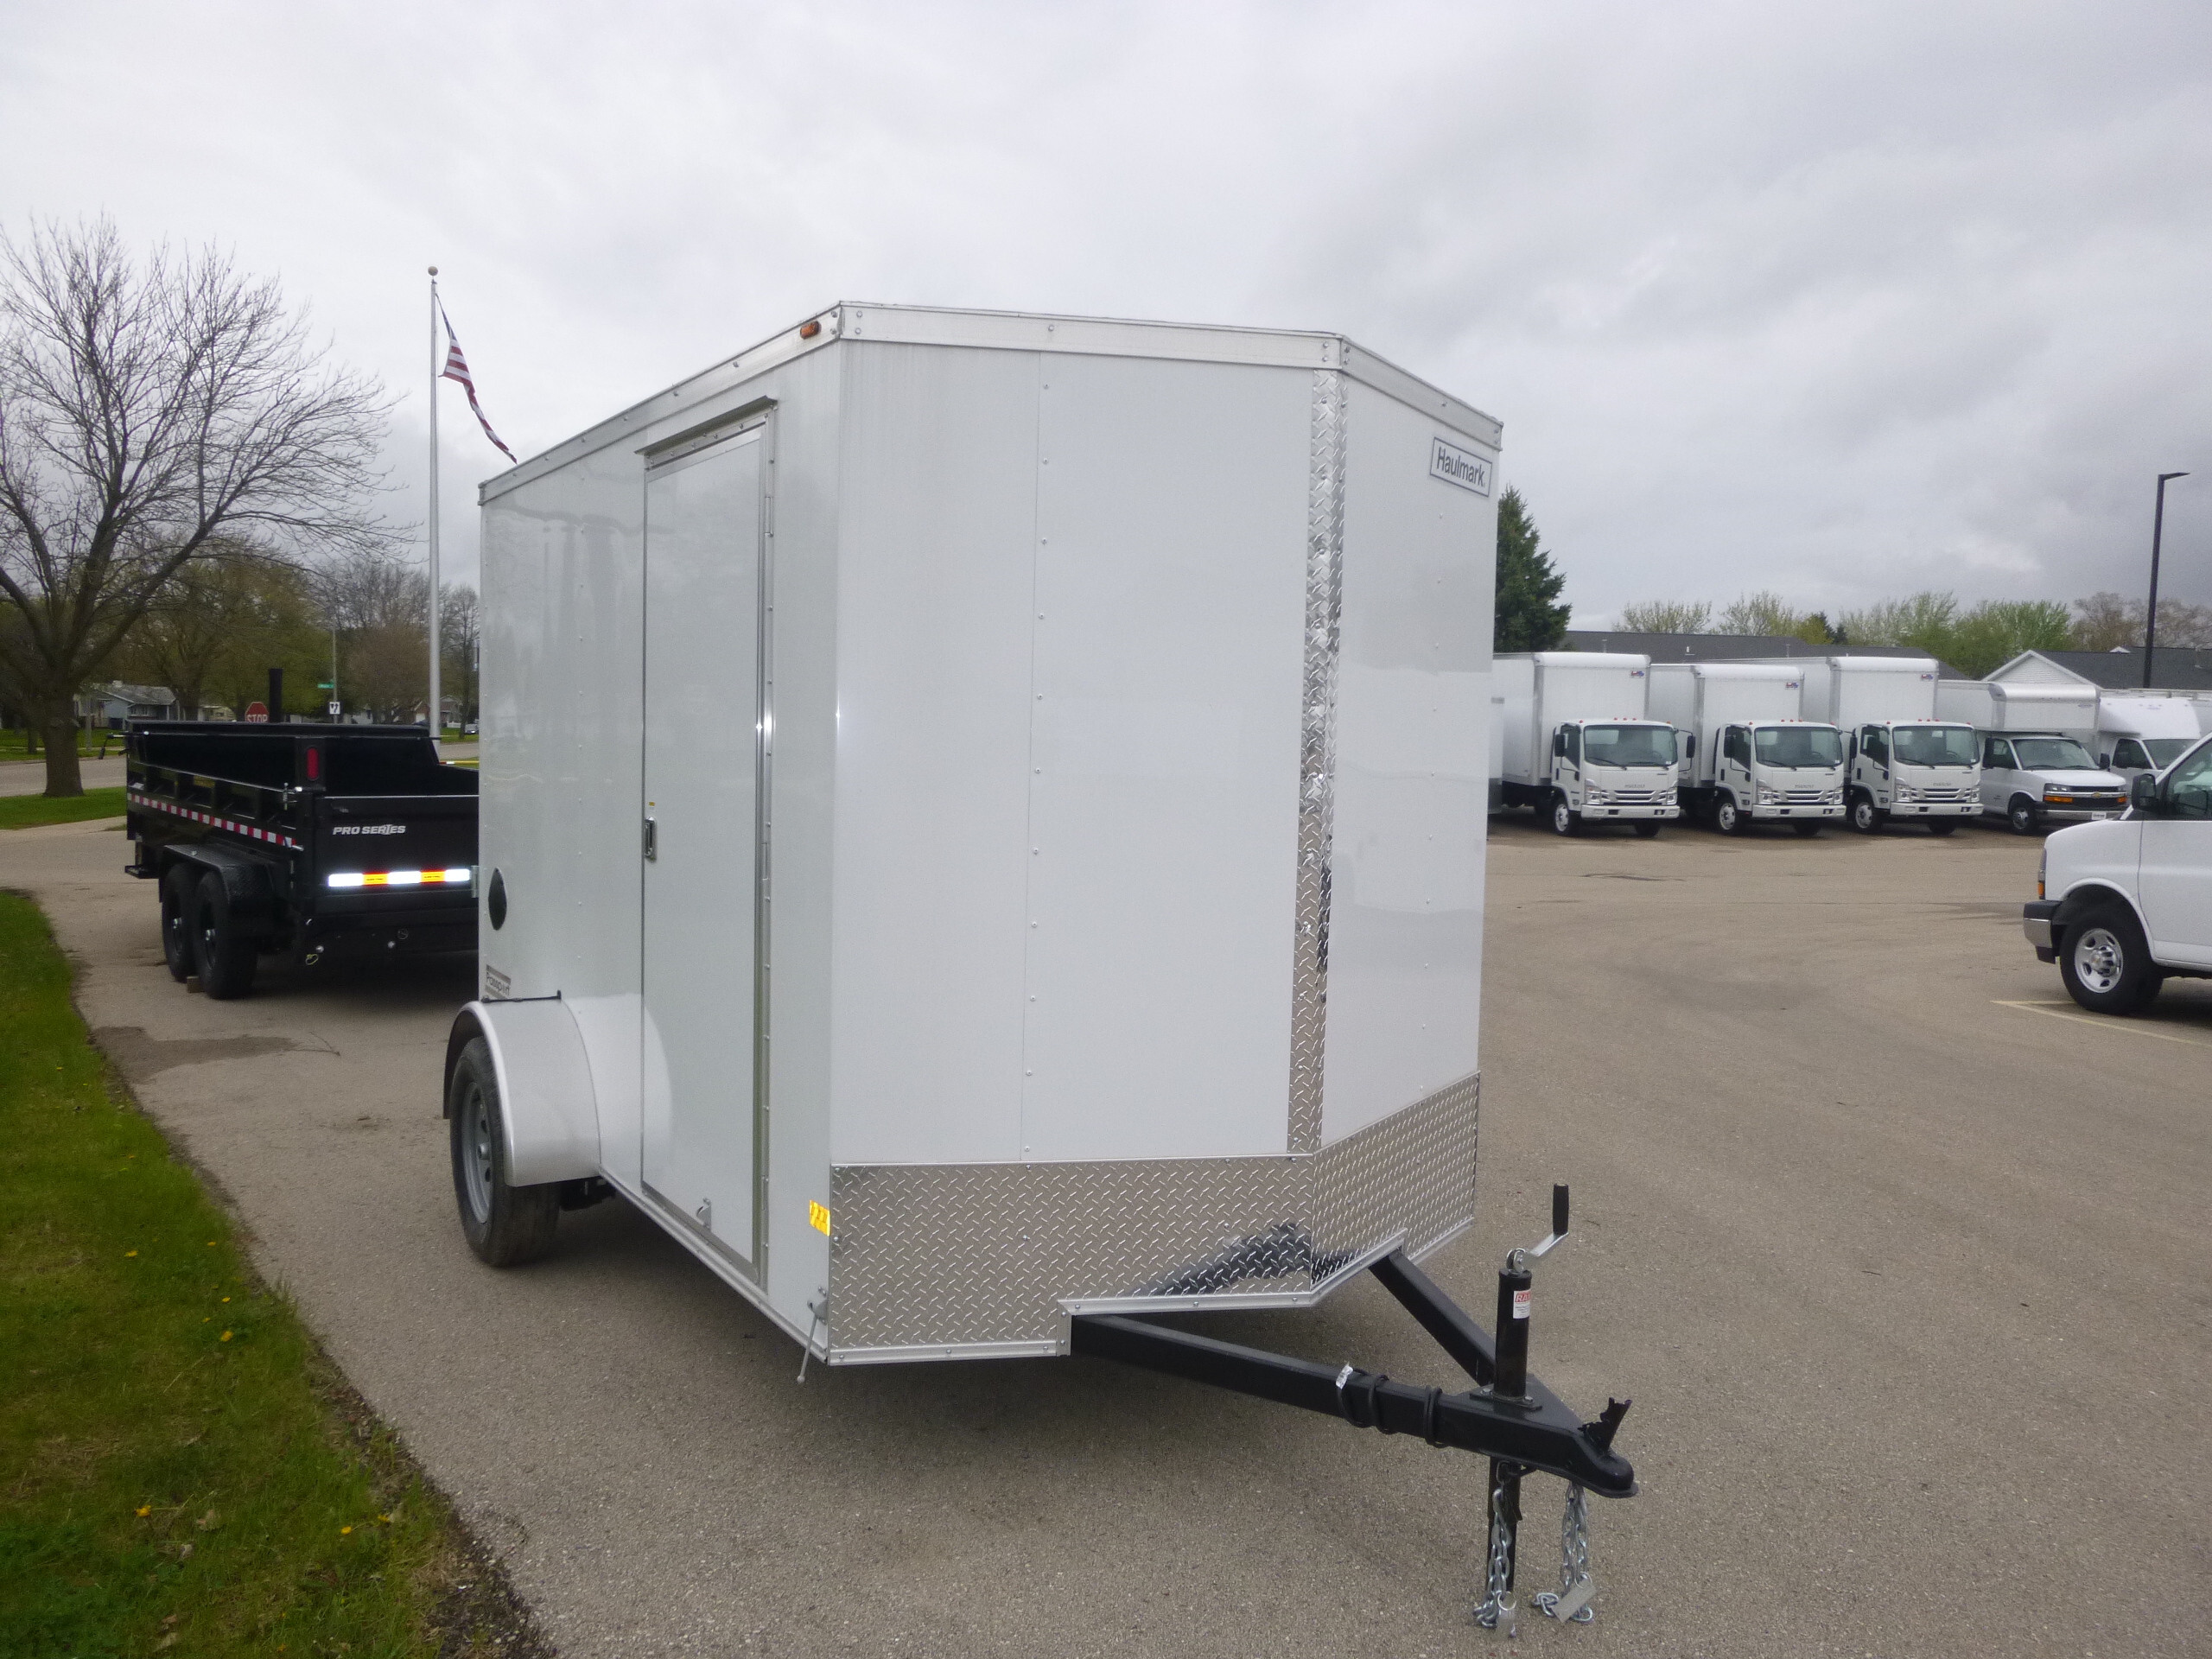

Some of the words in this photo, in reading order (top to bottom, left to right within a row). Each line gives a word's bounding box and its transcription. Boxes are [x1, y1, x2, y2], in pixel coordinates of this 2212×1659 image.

[1436, 446, 1485, 487] Haulmark
[247, 714, 268, 723] STOP
[333, 826, 360, 836] PRO
[361, 823, 406, 836] SERIES
